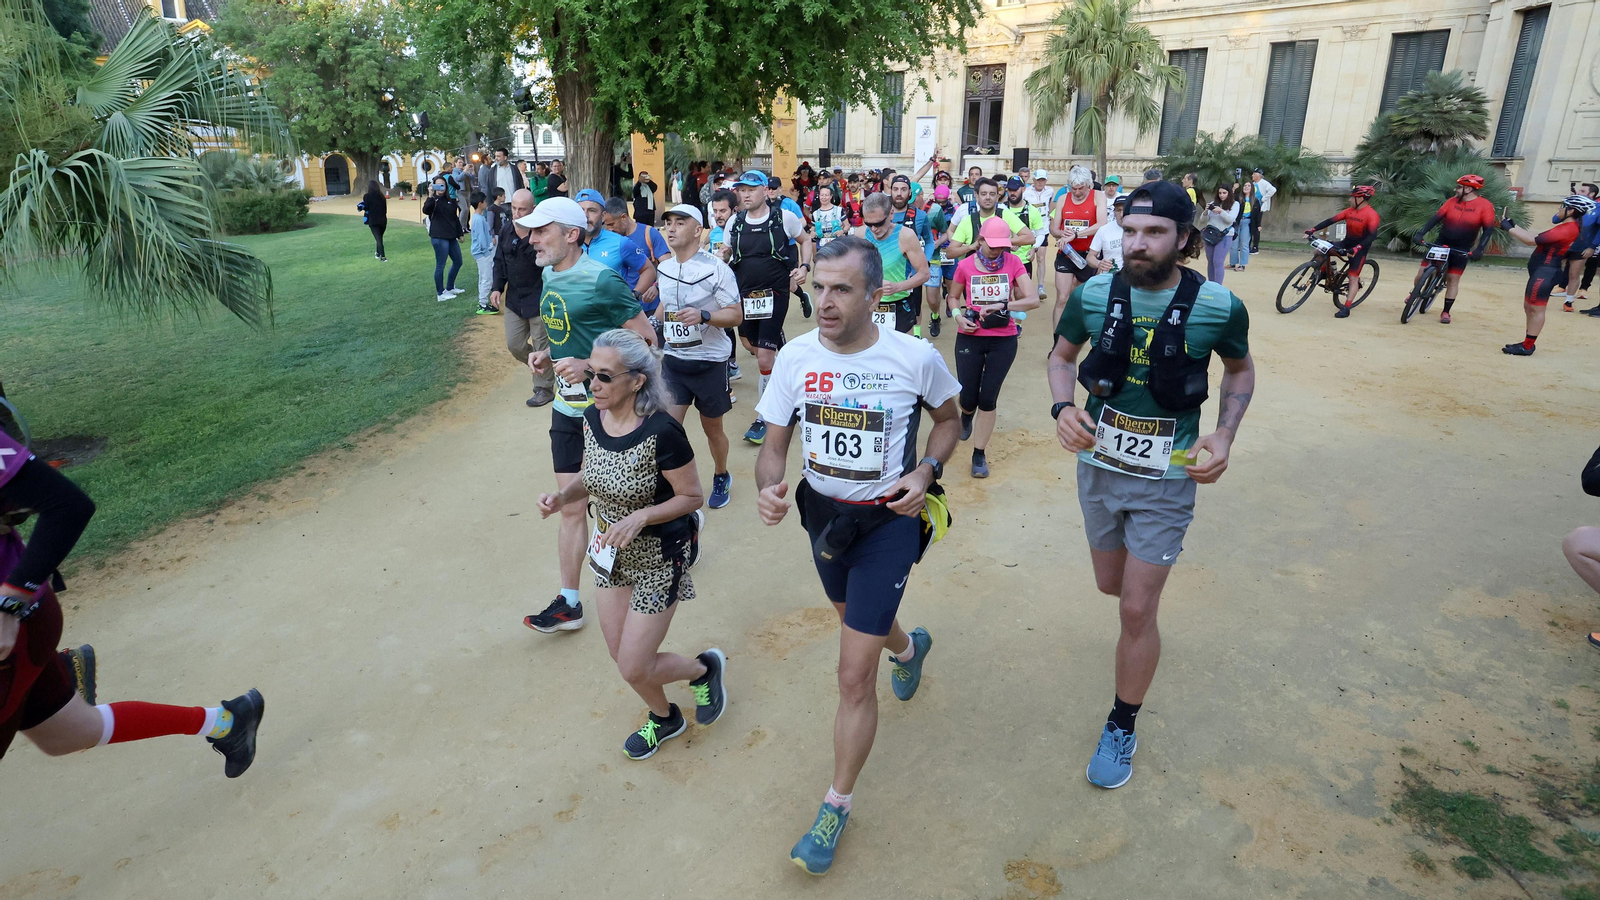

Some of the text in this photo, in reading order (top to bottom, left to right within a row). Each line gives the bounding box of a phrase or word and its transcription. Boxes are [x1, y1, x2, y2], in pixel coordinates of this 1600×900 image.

[981, 285, 1001, 297] 193
[751, 299, 767, 310] 104
[873, 313, 886, 324] 28
[670, 324, 690, 338] 168
[805, 371, 842, 393] 26°
[861, 373, 895, 381] SEVILLA
[861, 383, 889, 391] CORRE
[824, 407, 863, 425] Sherry
[1118, 414, 1155, 433] Sherry
[821, 430, 862, 459] 163
[1113, 432, 1154, 459] 122
